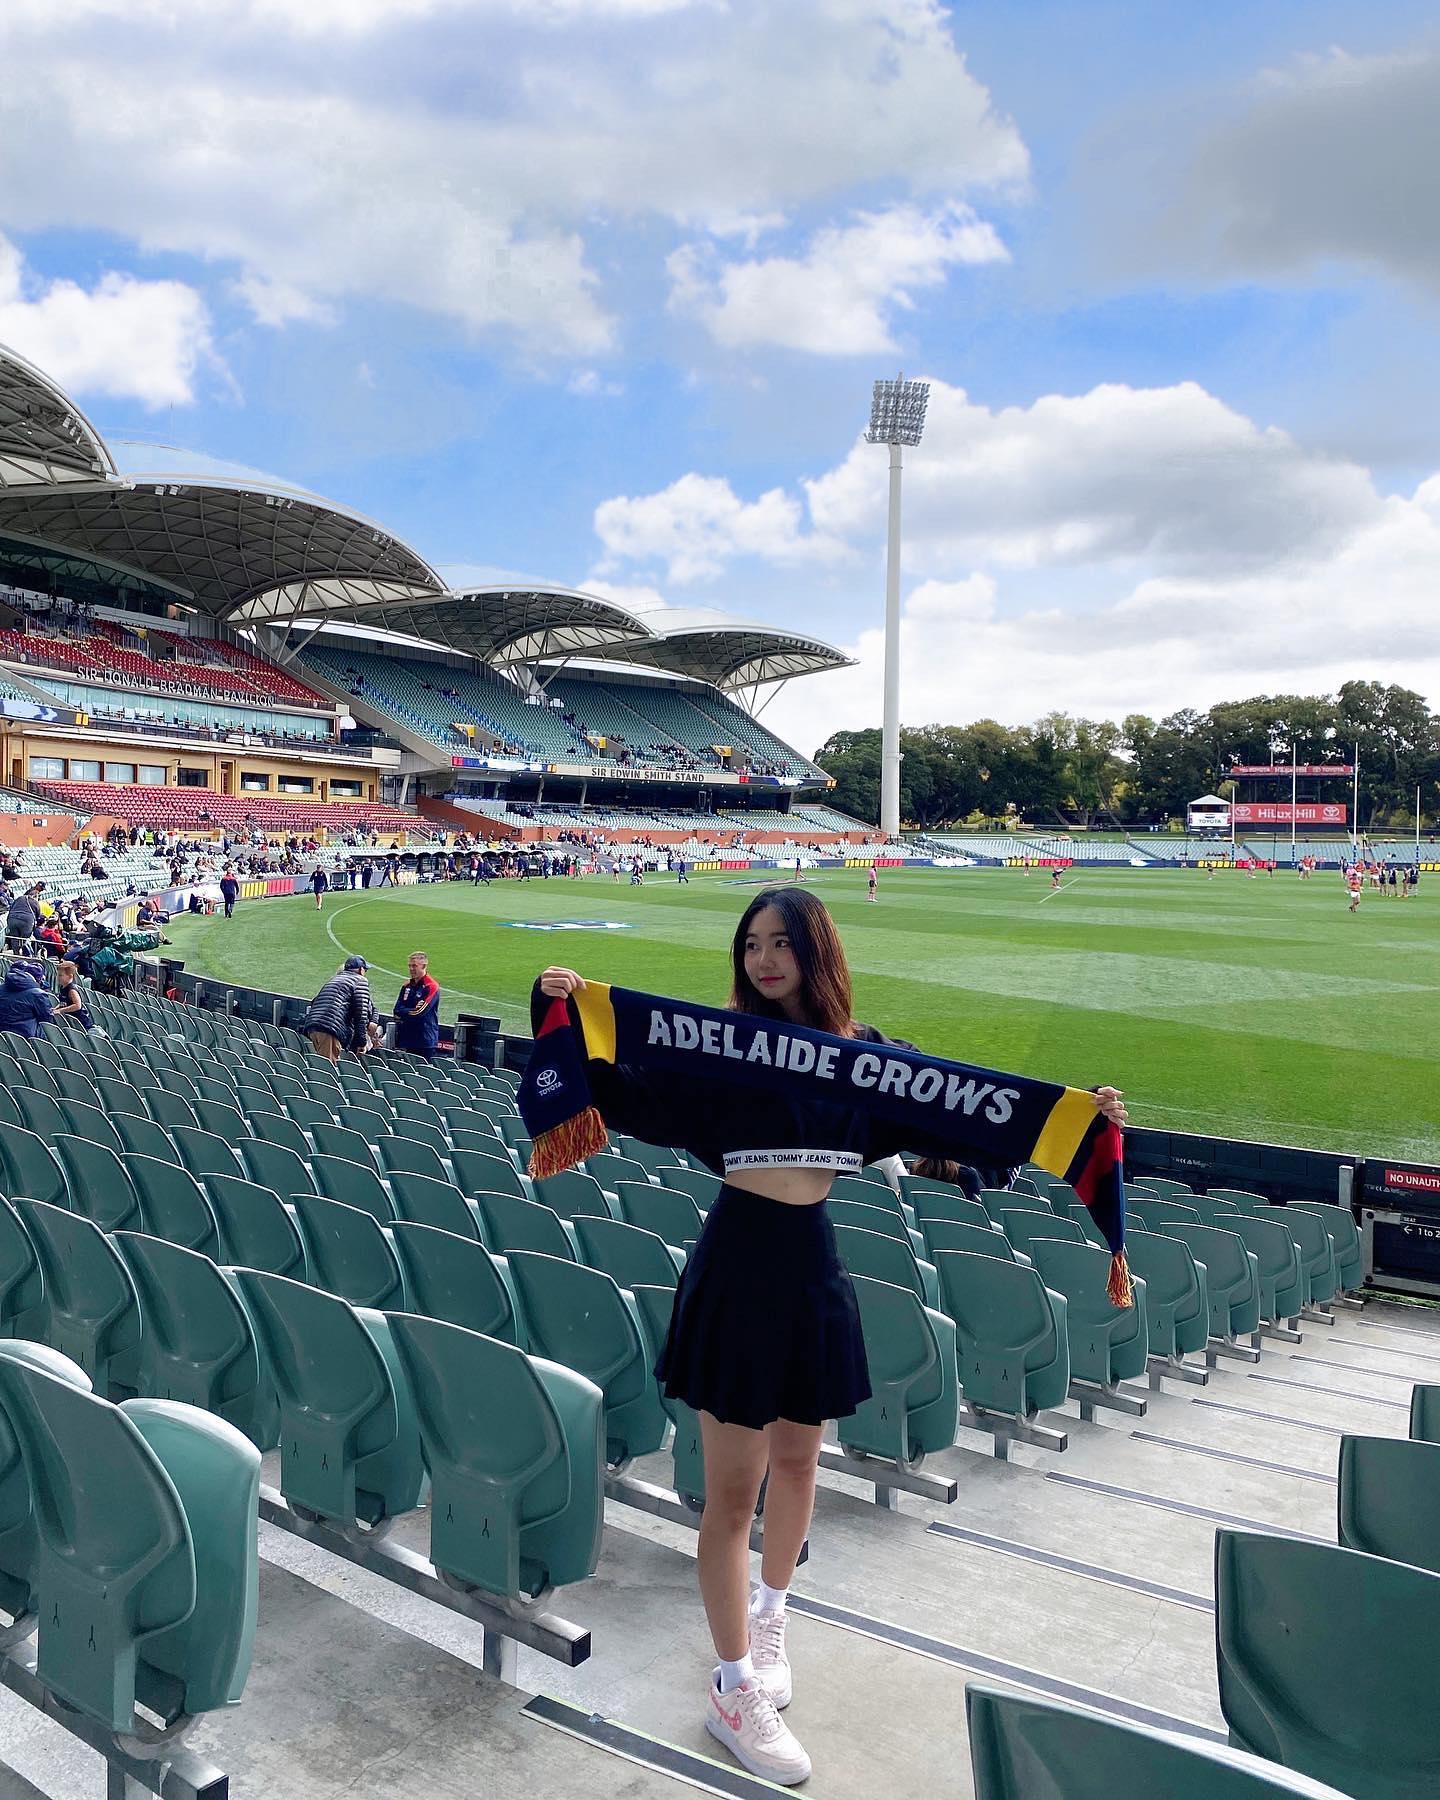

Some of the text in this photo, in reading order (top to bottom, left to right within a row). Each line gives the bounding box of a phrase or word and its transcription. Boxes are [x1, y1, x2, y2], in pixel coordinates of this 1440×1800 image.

[76, 665, 275, 707] SIR DONALD BRADMAN PAVILION
[591, 767, 705, 782] SIR EDWIN SMITH STAND
[1258, 808, 1291, 819] HiLux
[1295, 808, 1316, 819] Hill
[647, 1009, 1021, 1124] ADELAIDE CROWS
[538, 1081, 564, 1097] TOYOTA
[744, 1154, 769, 1164] JEANS
[772, 1154, 803, 1163] TOMMY
[805, 1154, 832, 1164] JEANS
[1390, 1173, 1404, 1183] NO
[1424, 1228, 1433, 1237] to
